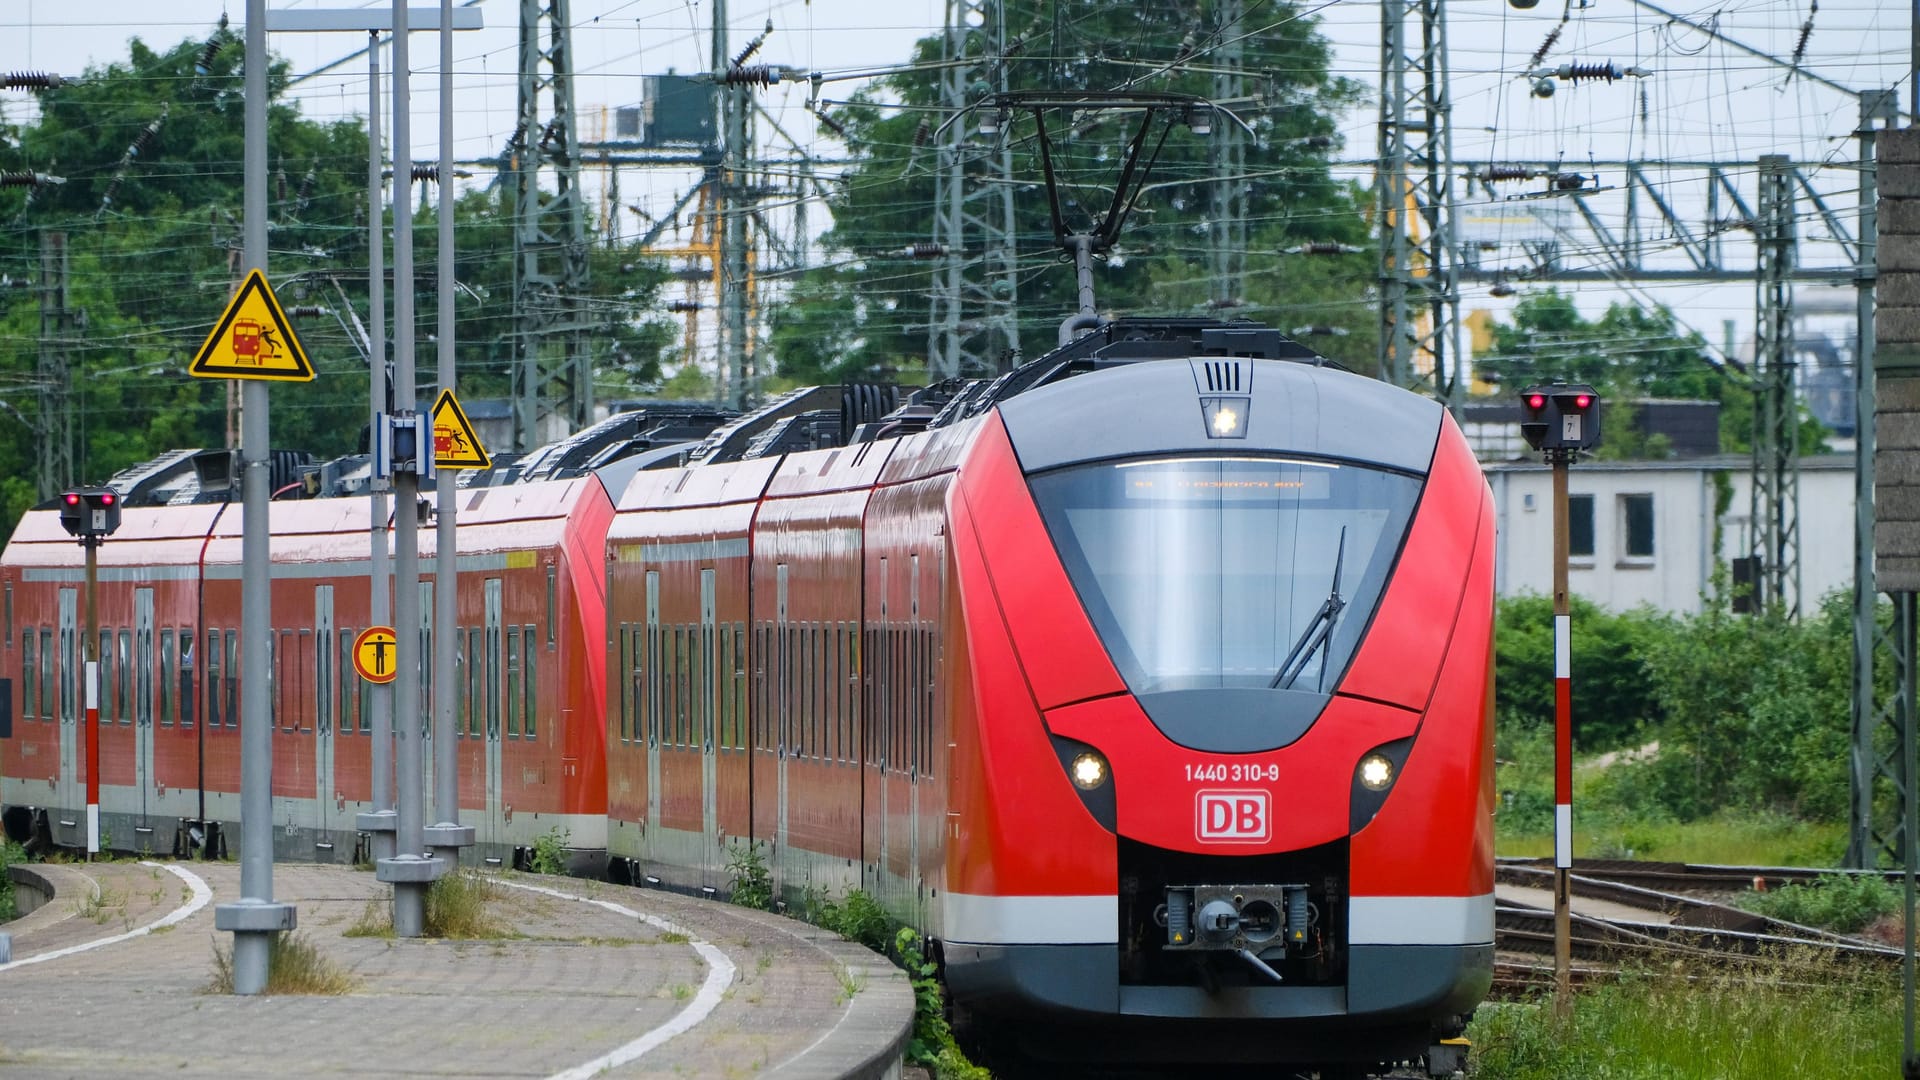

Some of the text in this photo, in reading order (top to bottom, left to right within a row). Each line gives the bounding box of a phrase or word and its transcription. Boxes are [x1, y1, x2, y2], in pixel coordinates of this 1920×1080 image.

[1185, 764, 1279, 782] 1440 310-9
[1205, 798, 1263, 835] DB
